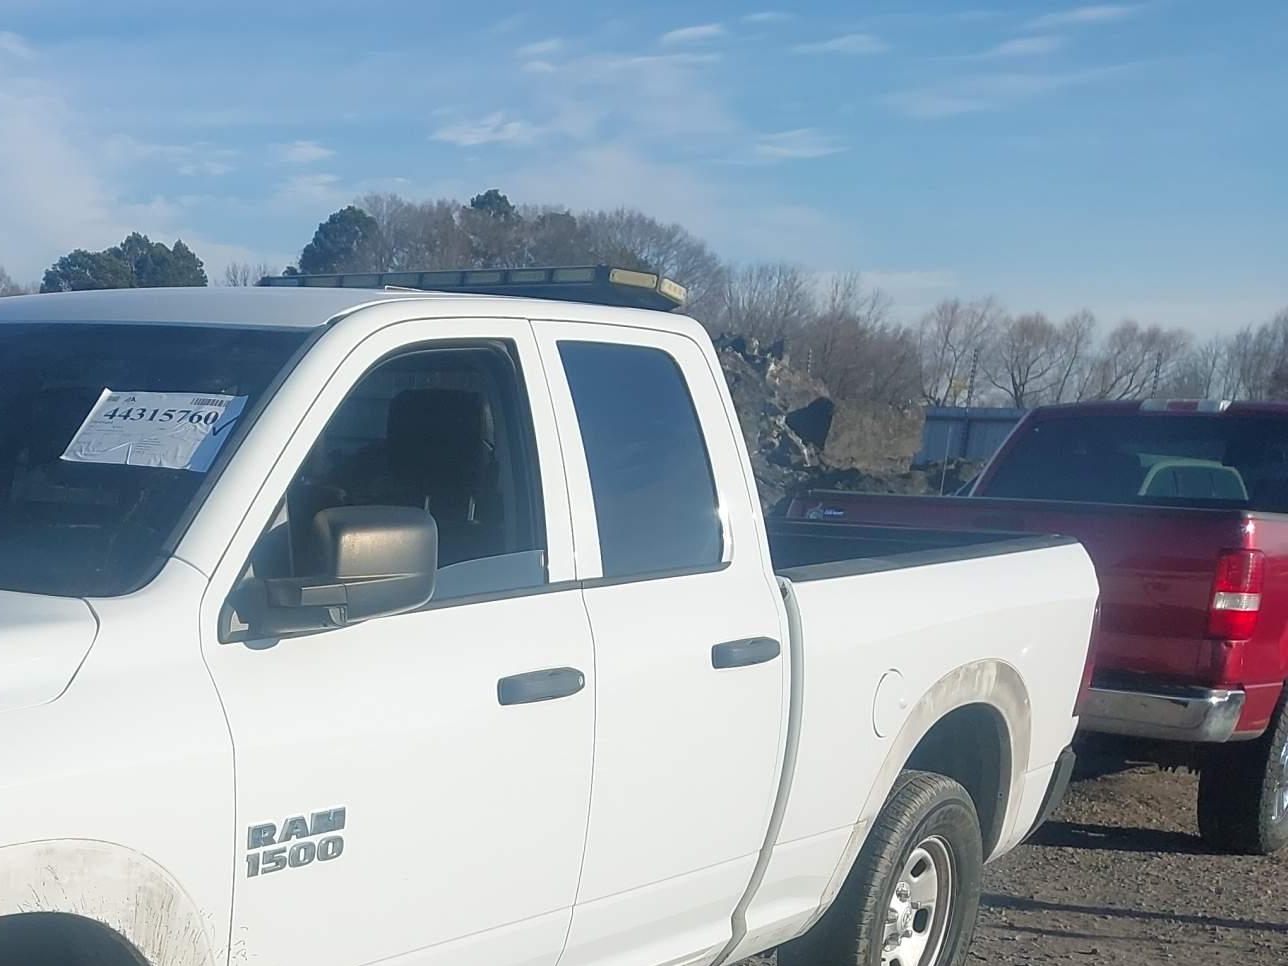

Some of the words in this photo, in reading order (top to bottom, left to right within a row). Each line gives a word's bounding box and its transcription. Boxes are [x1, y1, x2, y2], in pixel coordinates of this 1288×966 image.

[103, 407, 220, 425] 44315760
[247, 806, 346, 850] RAM
[246, 835, 345, 878] 1500
